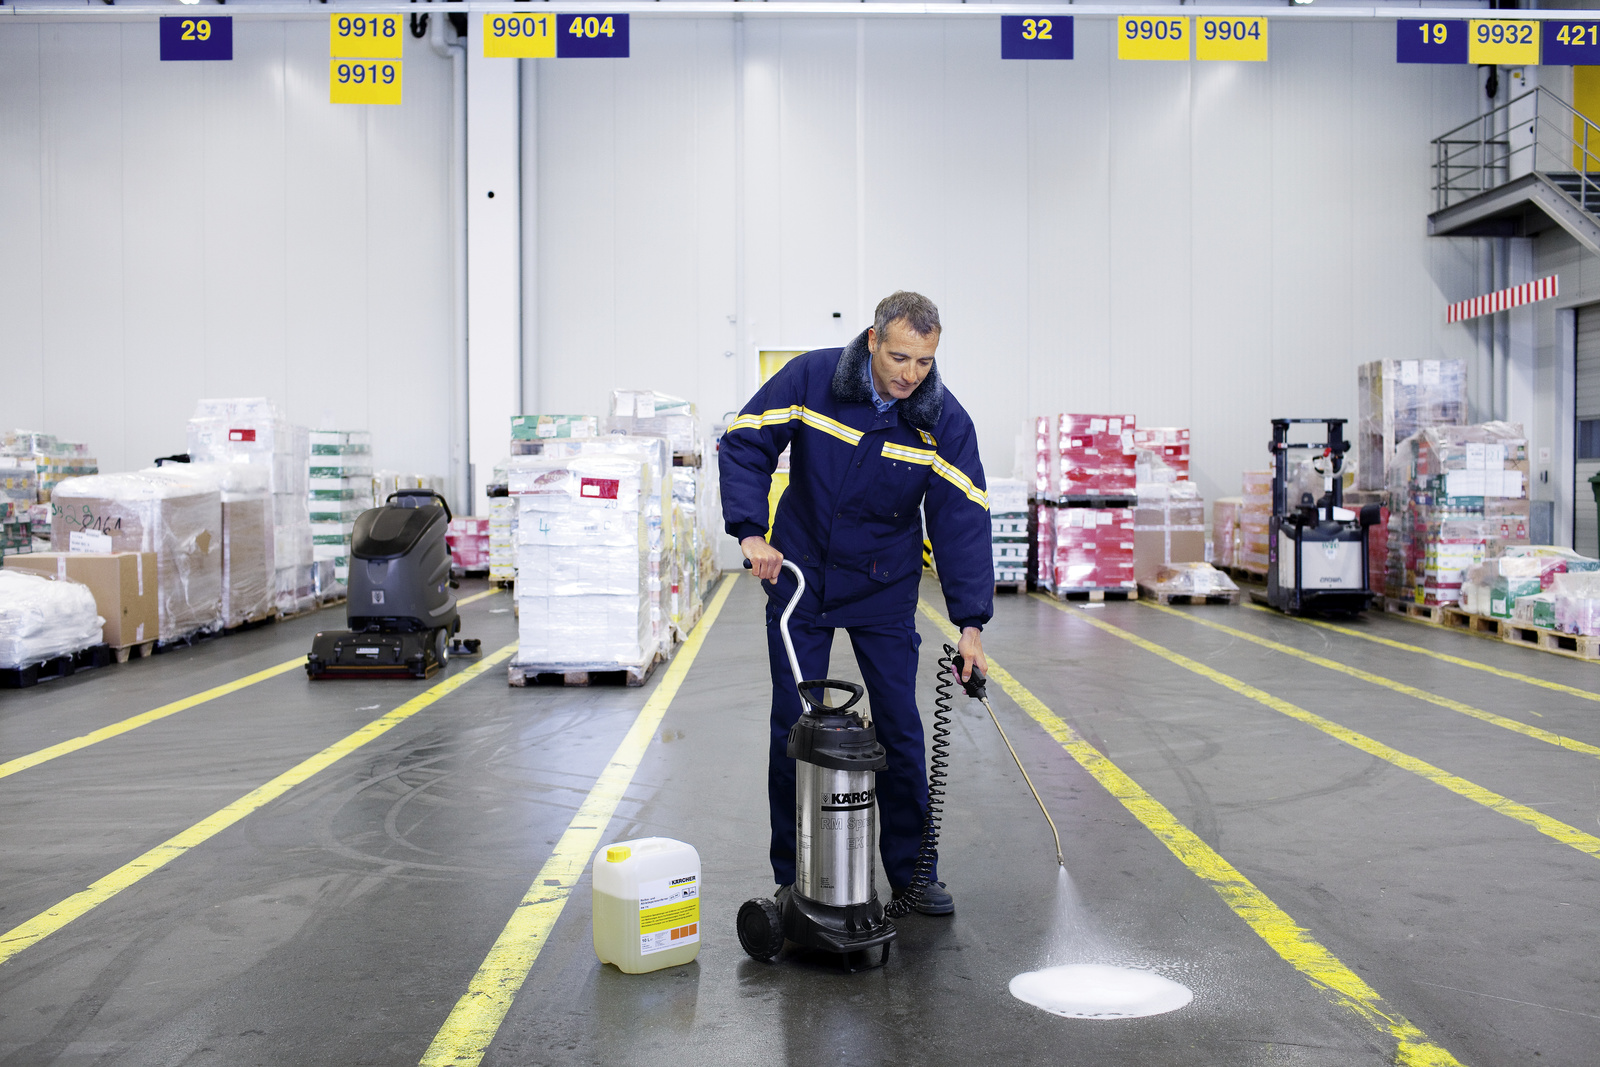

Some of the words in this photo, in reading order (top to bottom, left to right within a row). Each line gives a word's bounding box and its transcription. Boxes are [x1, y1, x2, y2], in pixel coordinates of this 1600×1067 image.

[181, 20, 211, 41] 29
[337, 17, 395, 38] 9918
[493, 17, 548, 38] 9901
[569, 17, 615, 38] 404
[1022, 19, 1052, 40] 32
[1126, 20, 1182, 40] 9905
[1203, 21, 1260, 41] 9904
[1419, 23, 1447, 44] 19
[1477, 24, 1533, 44] 9932
[1556, 25, 1598, 45] 421
[337, 64, 395, 84] 9919
[539, 518, 551, 538] 4
[832, 788, 875, 804] KÄRCH
[821, 818, 842, 830] RM
[847, 816, 874, 832] Spra
[846, 836, 864, 850] EK
